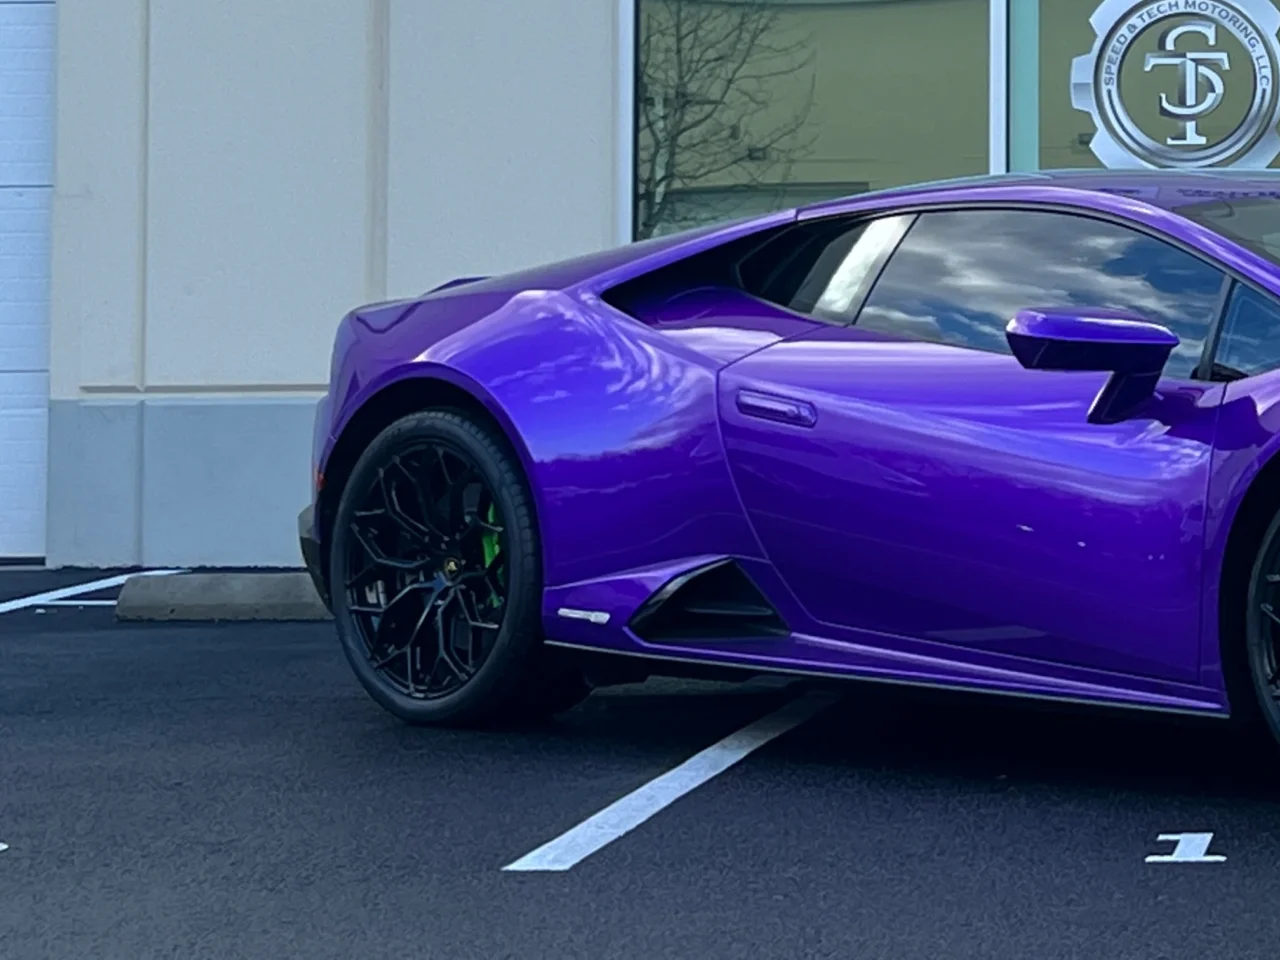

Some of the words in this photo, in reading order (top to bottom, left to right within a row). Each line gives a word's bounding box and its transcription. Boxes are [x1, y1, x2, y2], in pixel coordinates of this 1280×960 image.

[1103, 33, 1128, 86] SPEED
[1127, 23, 1139, 34] &
[1137, 0, 1180, 24] TECH
[1256, 54, 1271, 87] LLC
